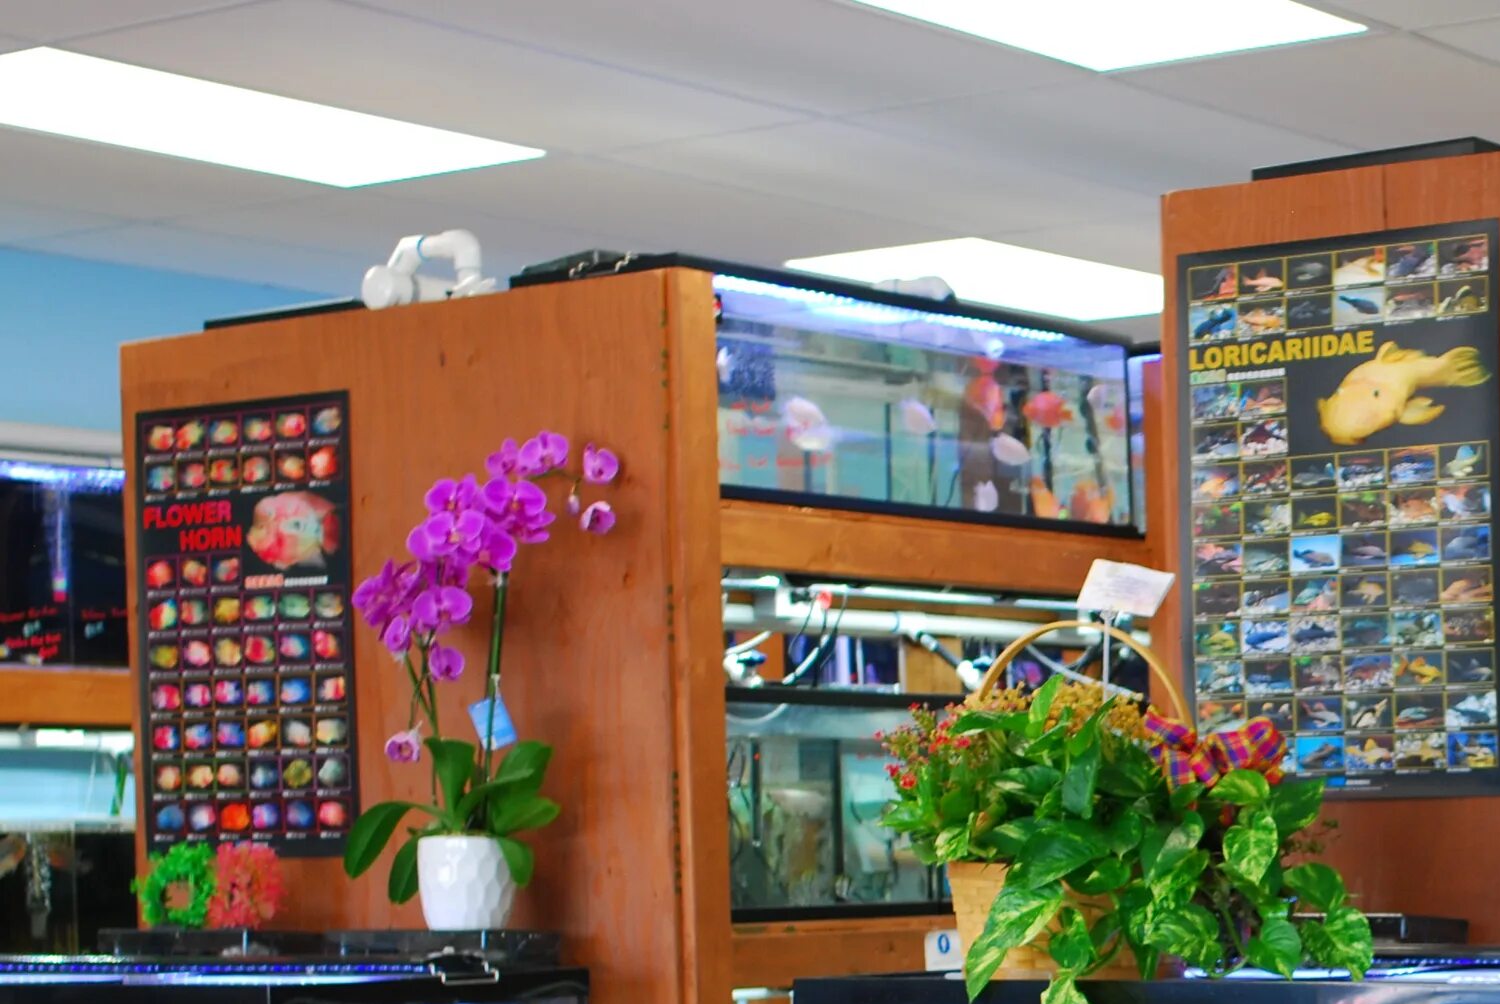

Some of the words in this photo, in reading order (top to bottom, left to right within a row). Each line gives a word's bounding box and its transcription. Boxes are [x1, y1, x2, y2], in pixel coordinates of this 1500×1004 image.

[1189, 330, 1375, 371] LORICARIIDAE
[143, 501, 232, 529] FLOWER
[179, 525, 242, 552] HORN
